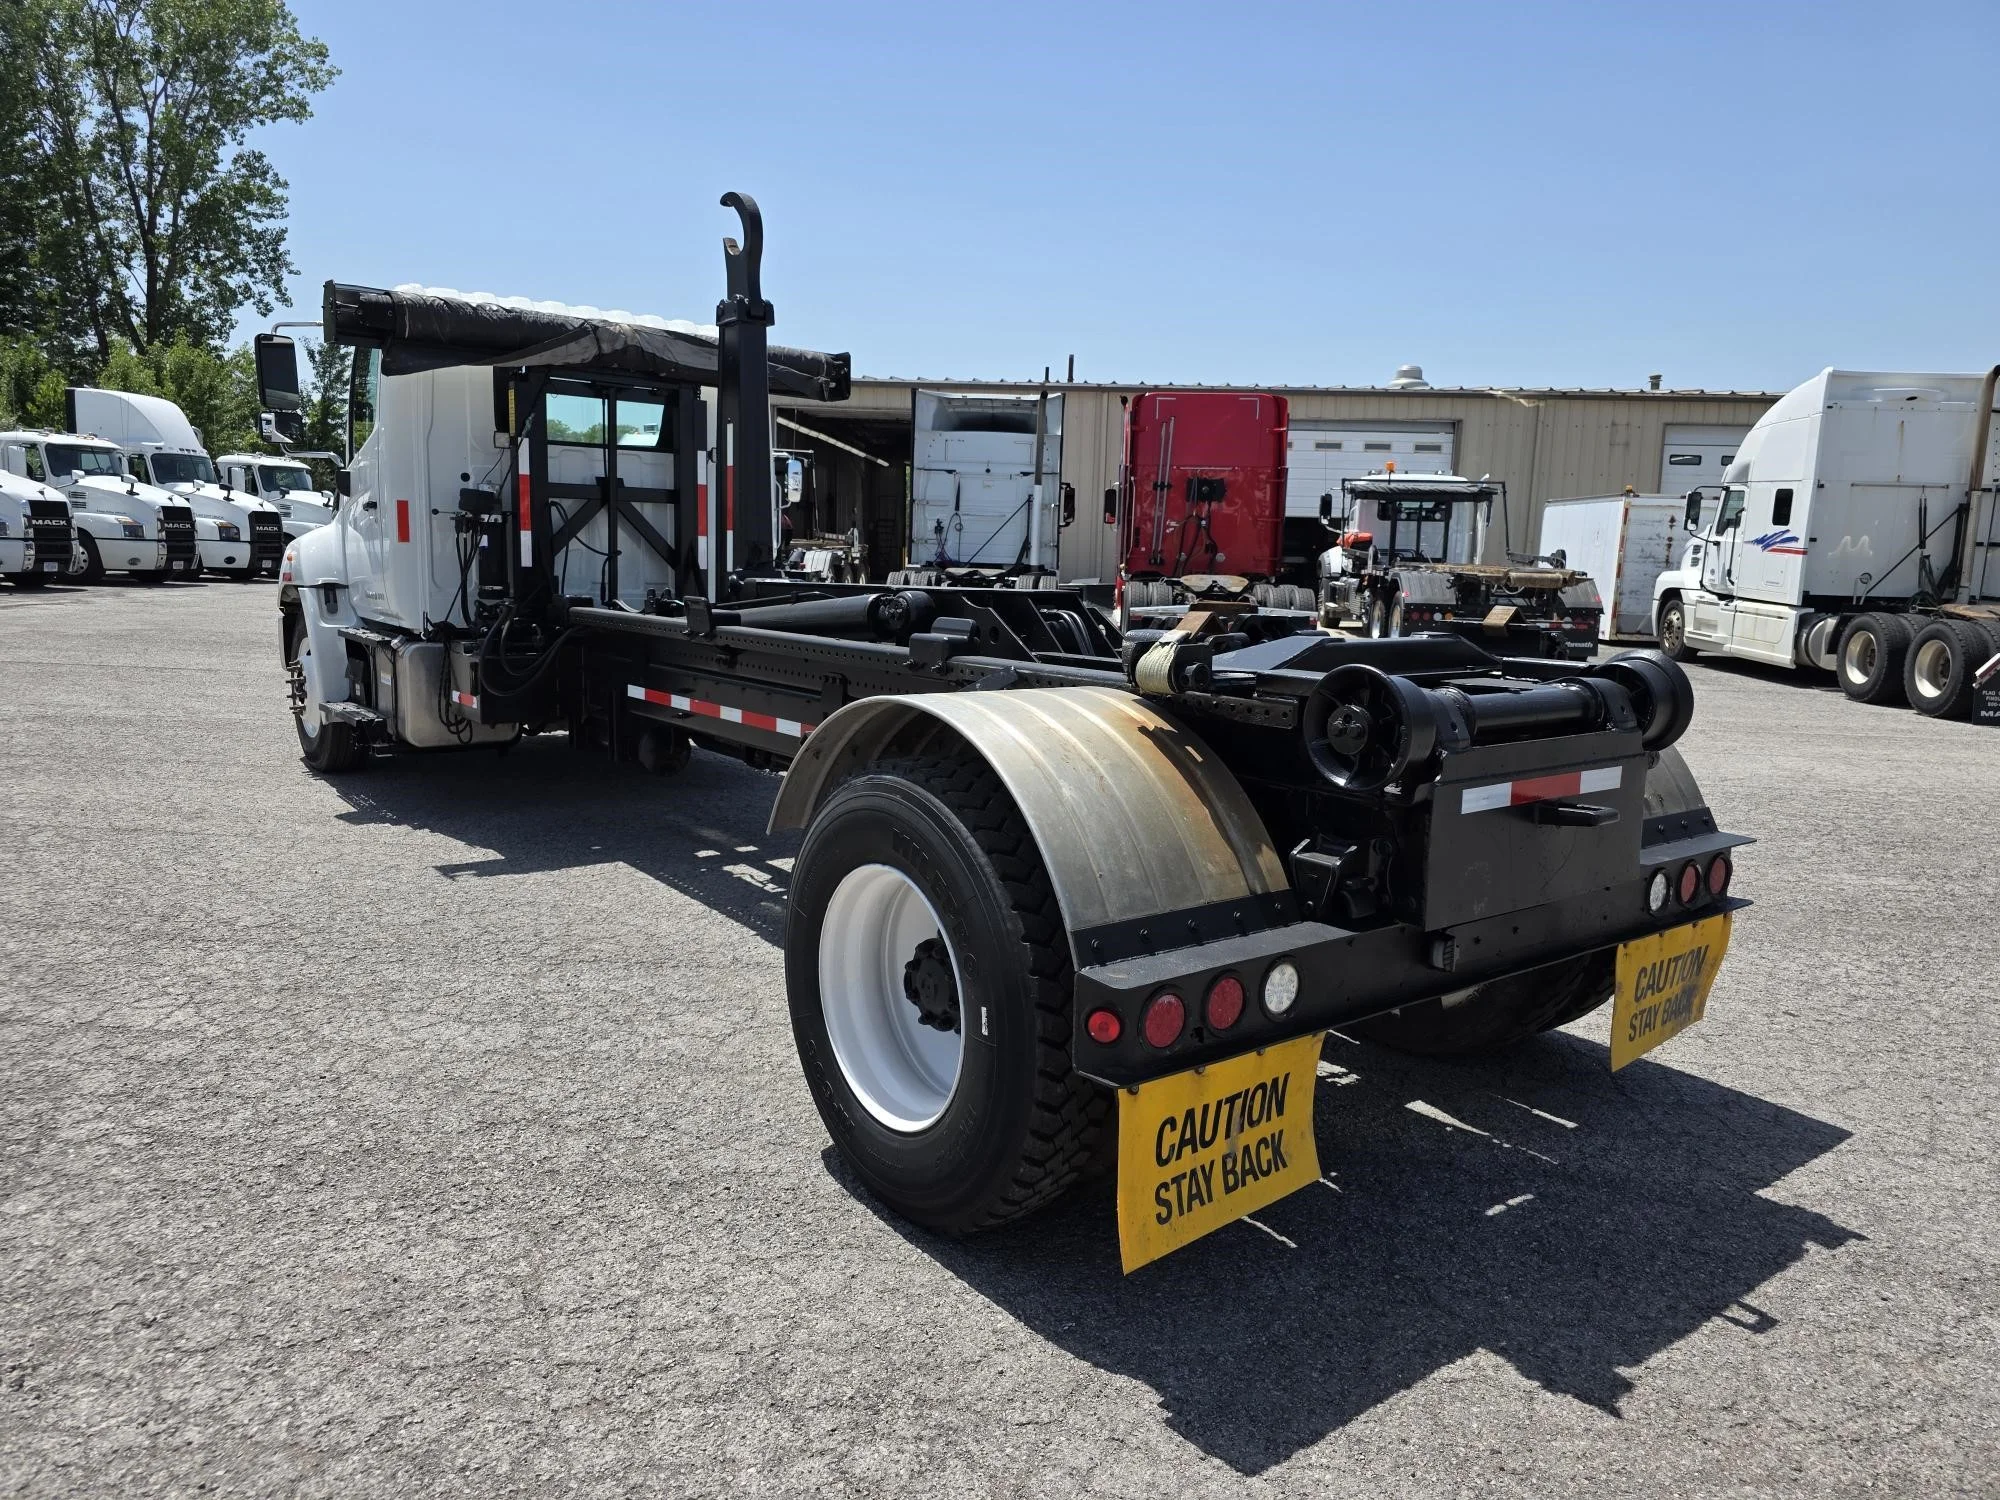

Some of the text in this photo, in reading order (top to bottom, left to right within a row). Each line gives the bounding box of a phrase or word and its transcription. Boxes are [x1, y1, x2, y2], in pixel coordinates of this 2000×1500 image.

[1629, 984, 1697, 1042] STAY BACK
[1634, 944, 1710, 1004] CAUTION
[1155, 1072, 1290, 1168] CAUTION
[1155, 1129, 1288, 1226] STAY BACK
